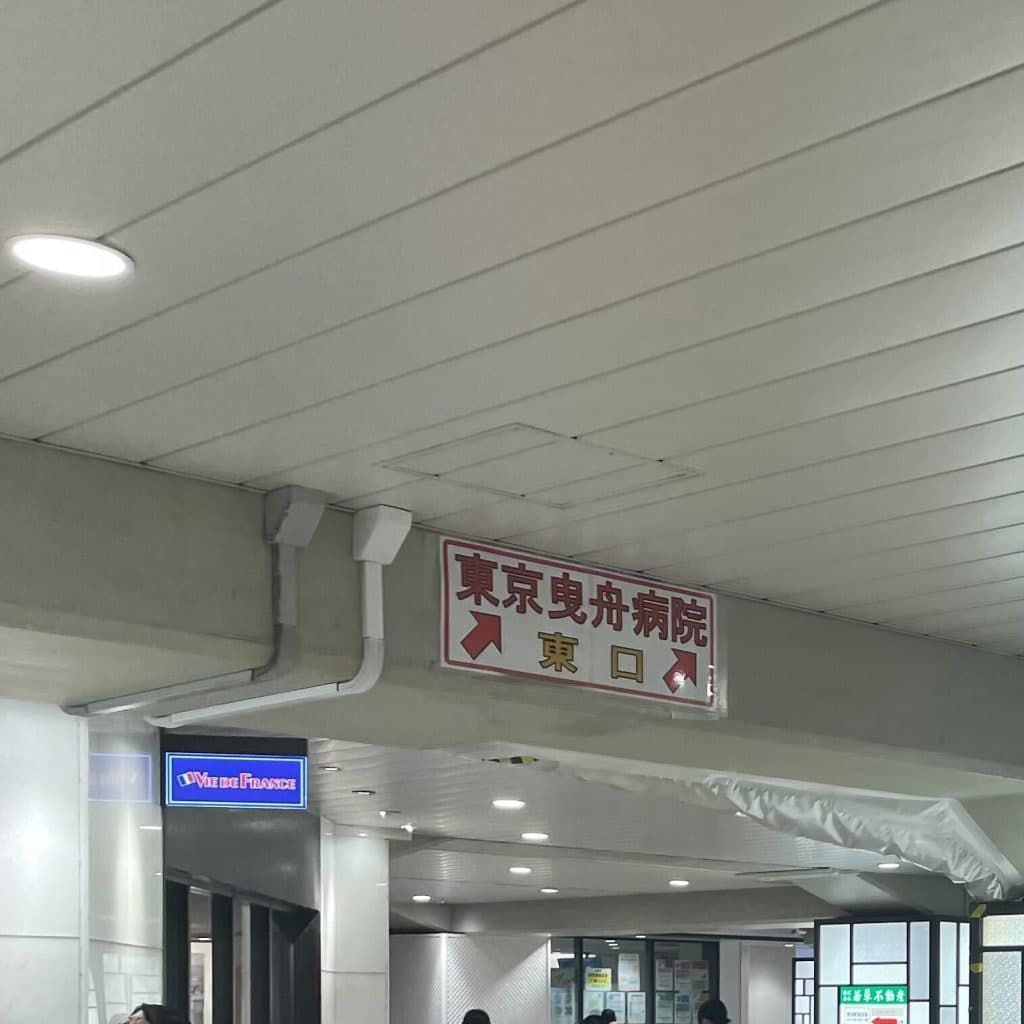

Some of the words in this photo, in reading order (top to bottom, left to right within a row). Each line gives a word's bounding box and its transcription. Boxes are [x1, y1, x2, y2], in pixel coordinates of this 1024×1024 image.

[455, 553, 707, 647] 東京曳舟病院
[538, 632, 643, 683] 東口
[194, 771, 218, 788] VIE
[219, 776, 239, 789] DE
[239, 773, 296, 790] FRANCE
